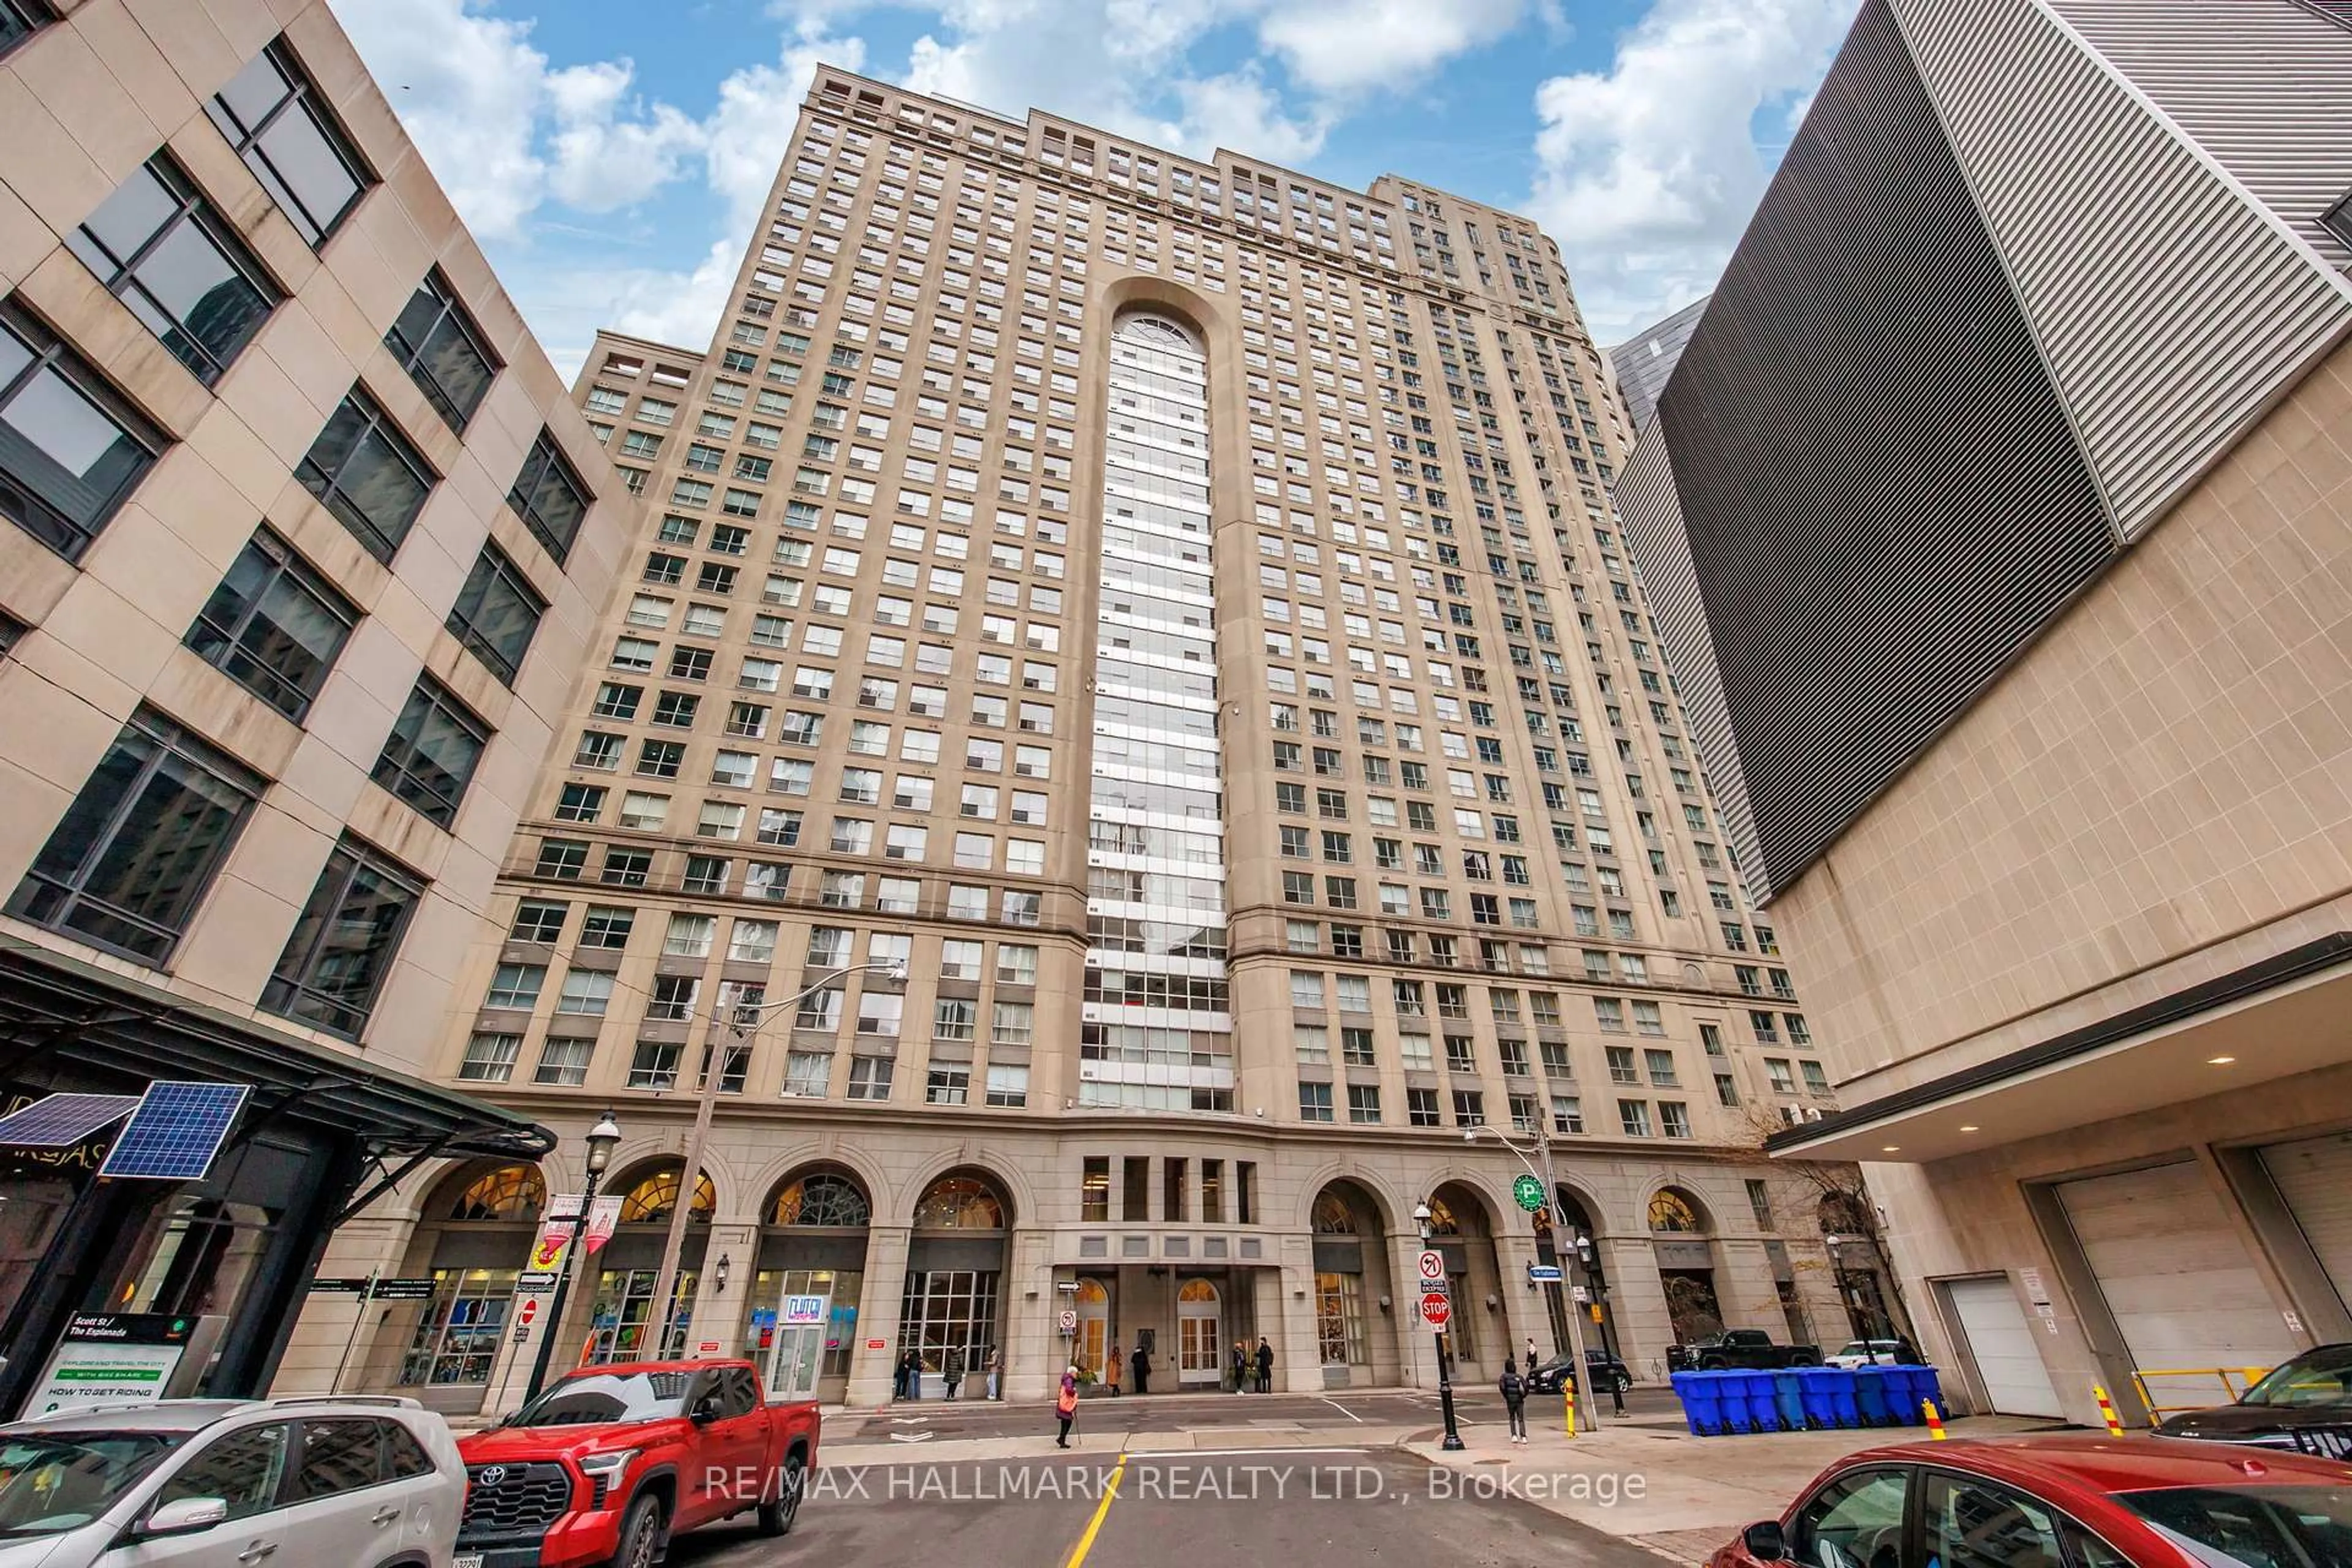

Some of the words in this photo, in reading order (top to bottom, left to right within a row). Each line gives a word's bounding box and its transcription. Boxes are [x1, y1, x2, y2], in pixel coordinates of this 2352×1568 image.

[1423, 1302, 1447, 1314] STOP
[75, 1317, 97, 1325] Scott
[86, 1328, 127, 1336] Esplanade
[116, 1388, 153, 1396] RIDING
